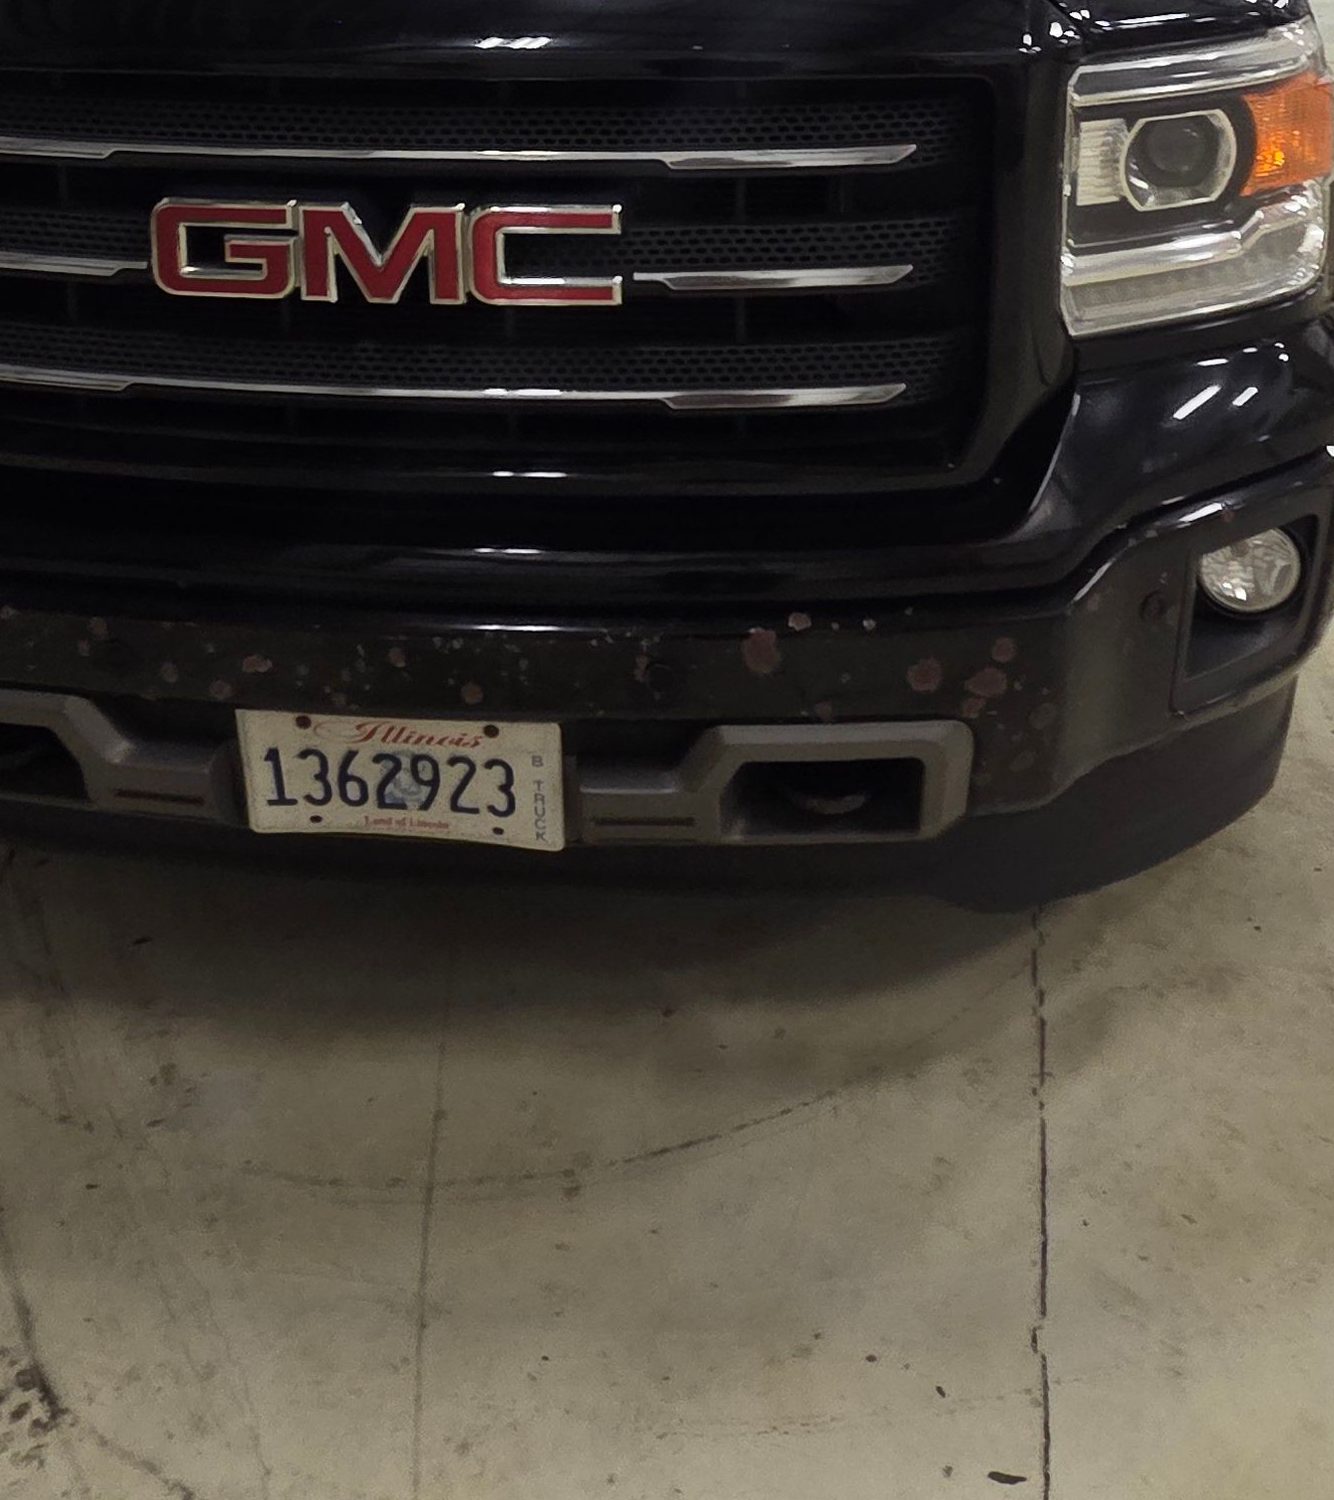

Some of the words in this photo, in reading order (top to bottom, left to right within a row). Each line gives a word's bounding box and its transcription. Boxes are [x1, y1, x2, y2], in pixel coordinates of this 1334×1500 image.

[151, 198, 623, 306] GMC
[313, 719, 483, 749] Illinois
[531, 754, 544, 768] B
[263, 747, 516, 818] 1362923
[532, 779, 549, 842] TRUCK
